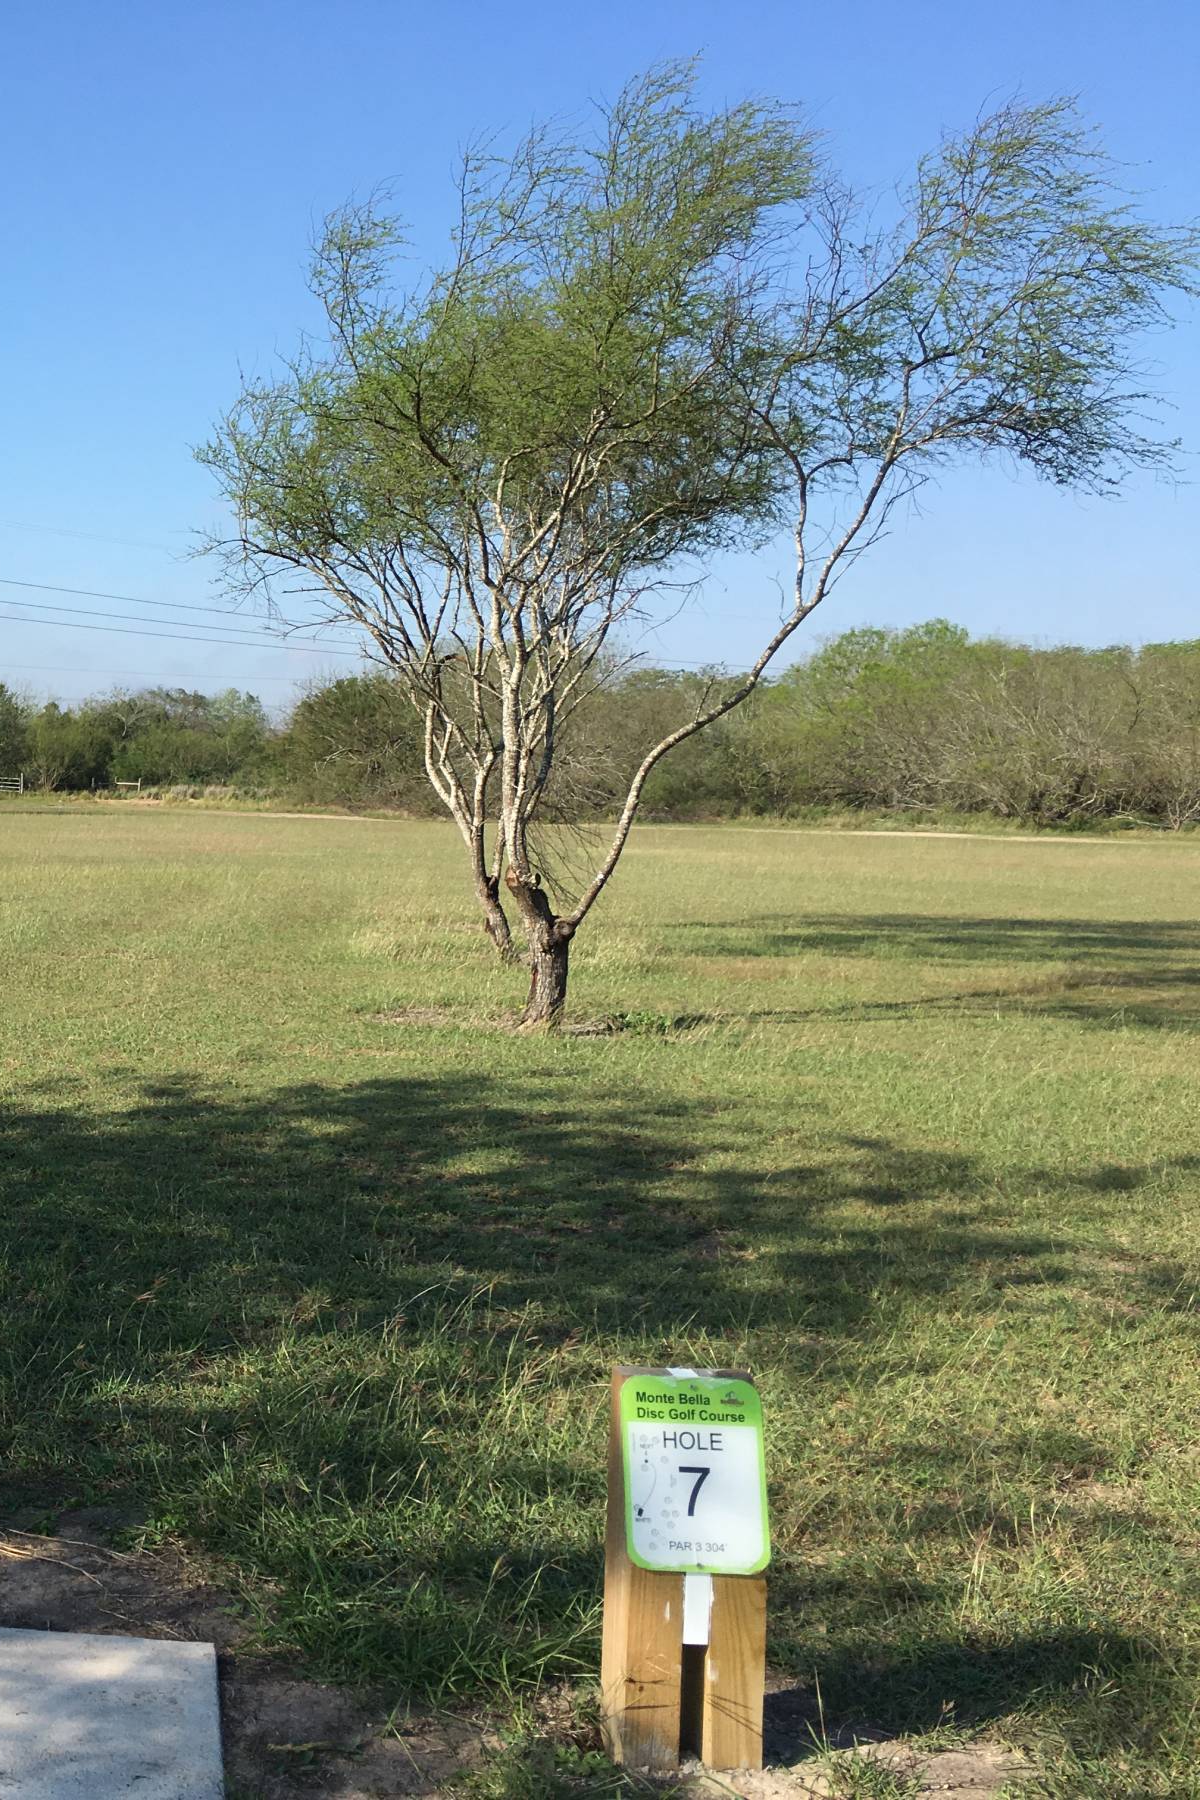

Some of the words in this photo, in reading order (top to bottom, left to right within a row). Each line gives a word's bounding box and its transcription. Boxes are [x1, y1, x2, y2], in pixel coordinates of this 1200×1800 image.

[636, 1391, 674, 1404] Monte
[679, 1393, 710, 1406] Bella
[637, 1407, 664, 1419] Disc
[668, 1407, 695, 1420] Golf
[699, 1409, 745, 1423] Course
[663, 1430, 723, 1451] HOLE
[678, 1466, 710, 1517] 7
[669, 1541, 692, 1551] PAR
[695, 1542, 702, 1551] 3
